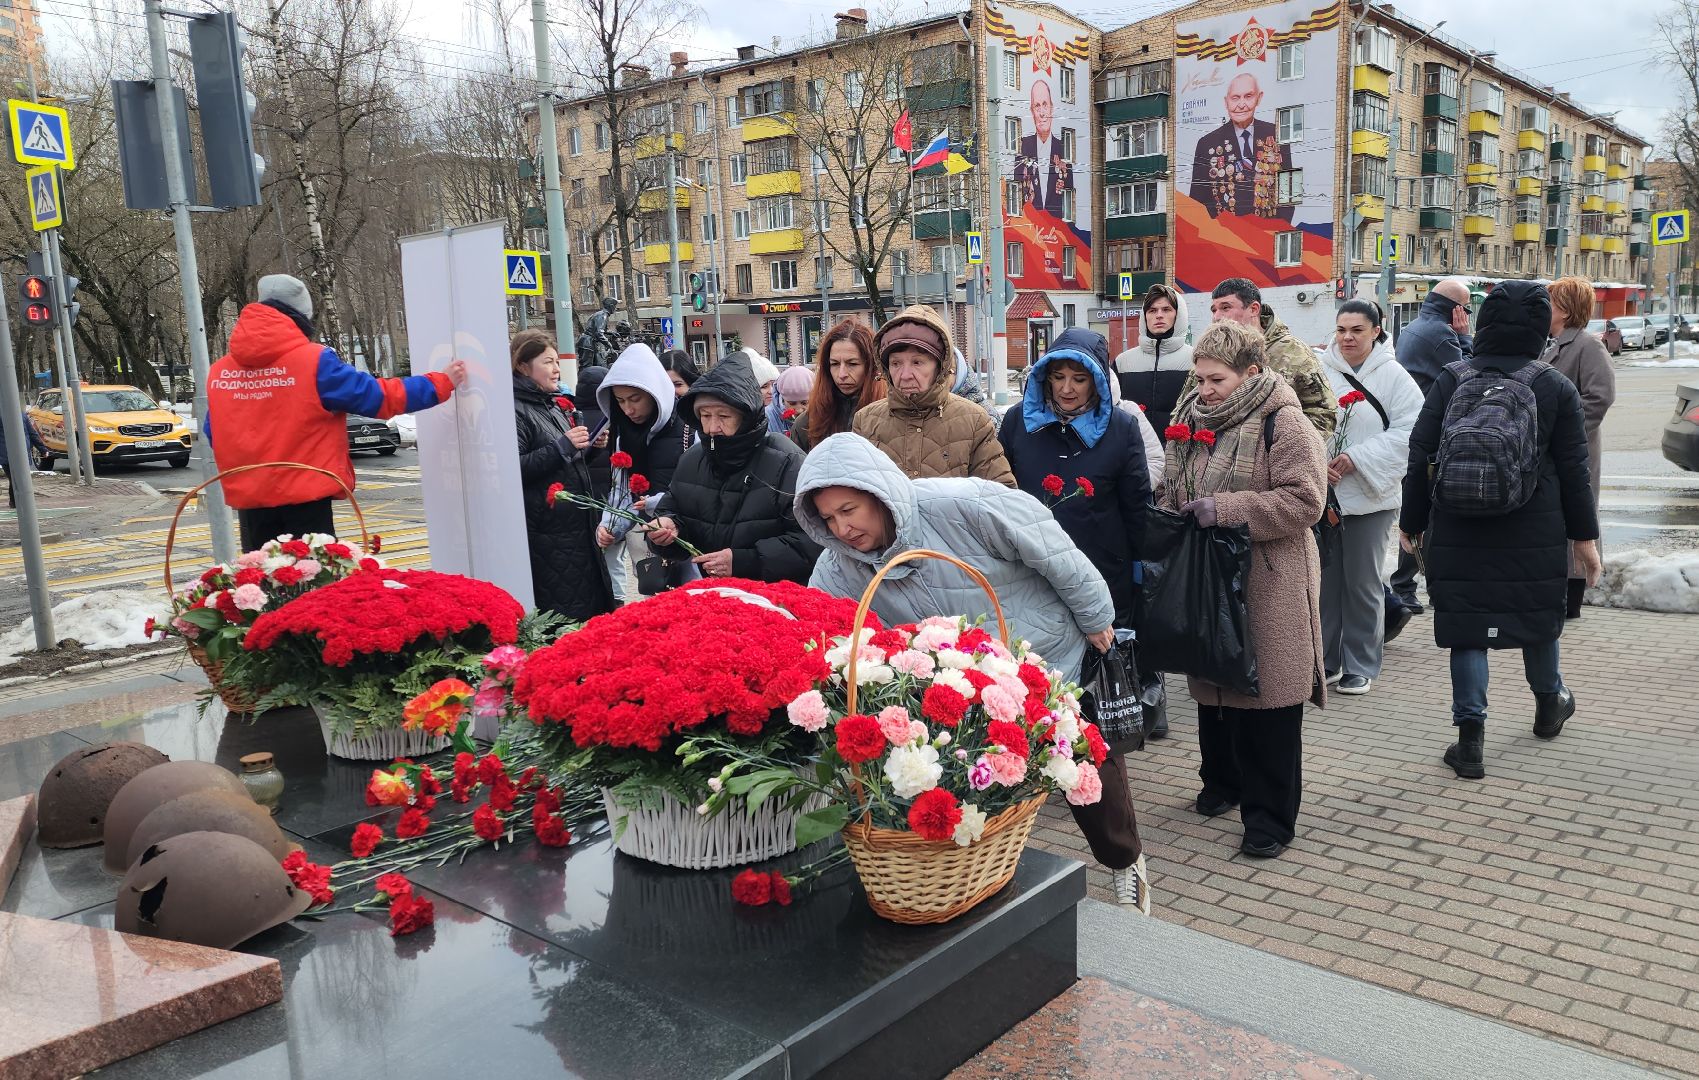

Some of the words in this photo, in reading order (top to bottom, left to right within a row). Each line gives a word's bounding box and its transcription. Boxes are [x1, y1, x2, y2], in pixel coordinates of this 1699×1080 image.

[29, 306, 48, 320] 61
[1096, 310, 1122, 319] САЛОН
[210, 377, 296, 390] ПОДМОСКОВЬЯ
[249, 391, 273, 400] РЯДОМ
